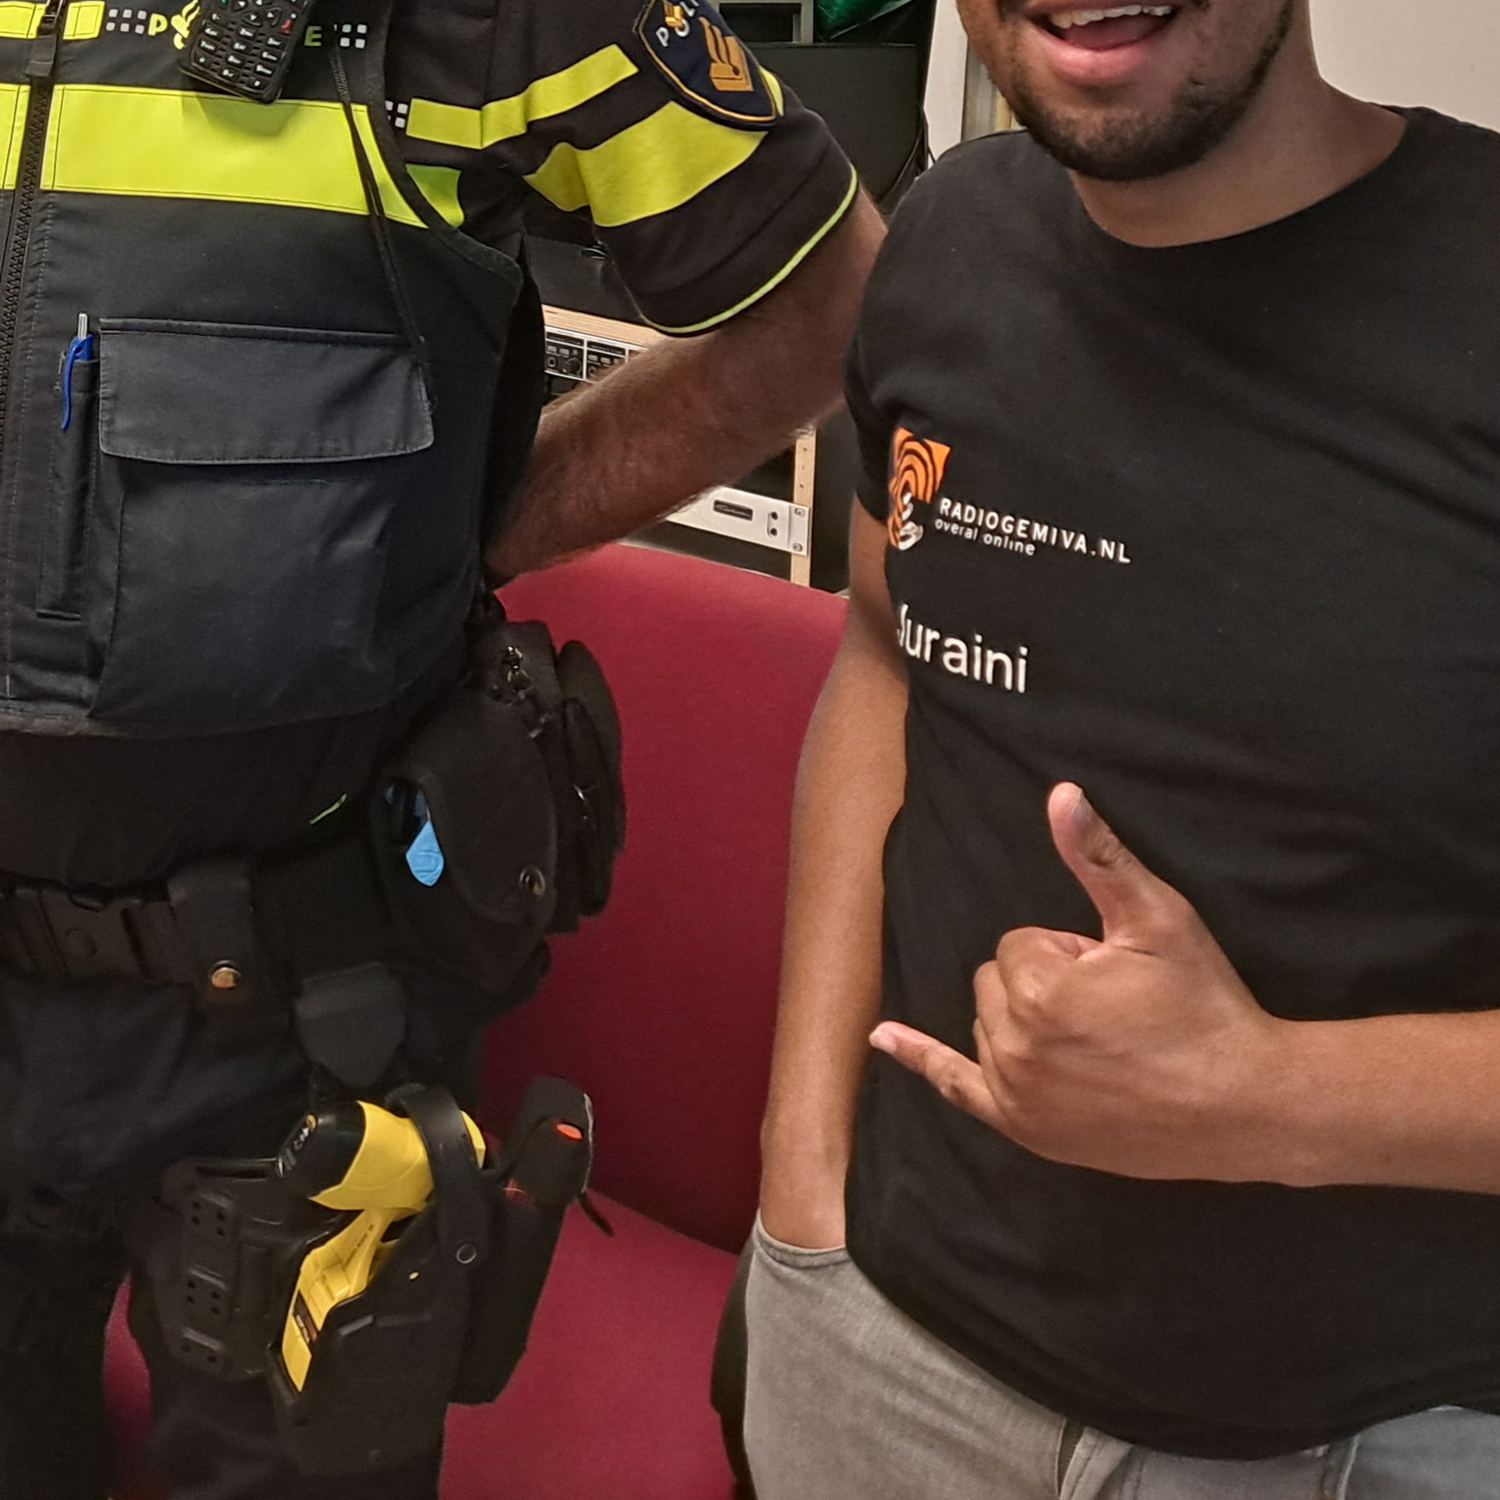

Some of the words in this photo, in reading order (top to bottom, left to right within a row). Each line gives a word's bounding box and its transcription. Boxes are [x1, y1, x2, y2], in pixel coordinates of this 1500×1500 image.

[934, 518, 979, 541] overal
[983, 533, 1036, 557] online
[939, 497, 1132, 564] RADIOGEMIVA.NL
